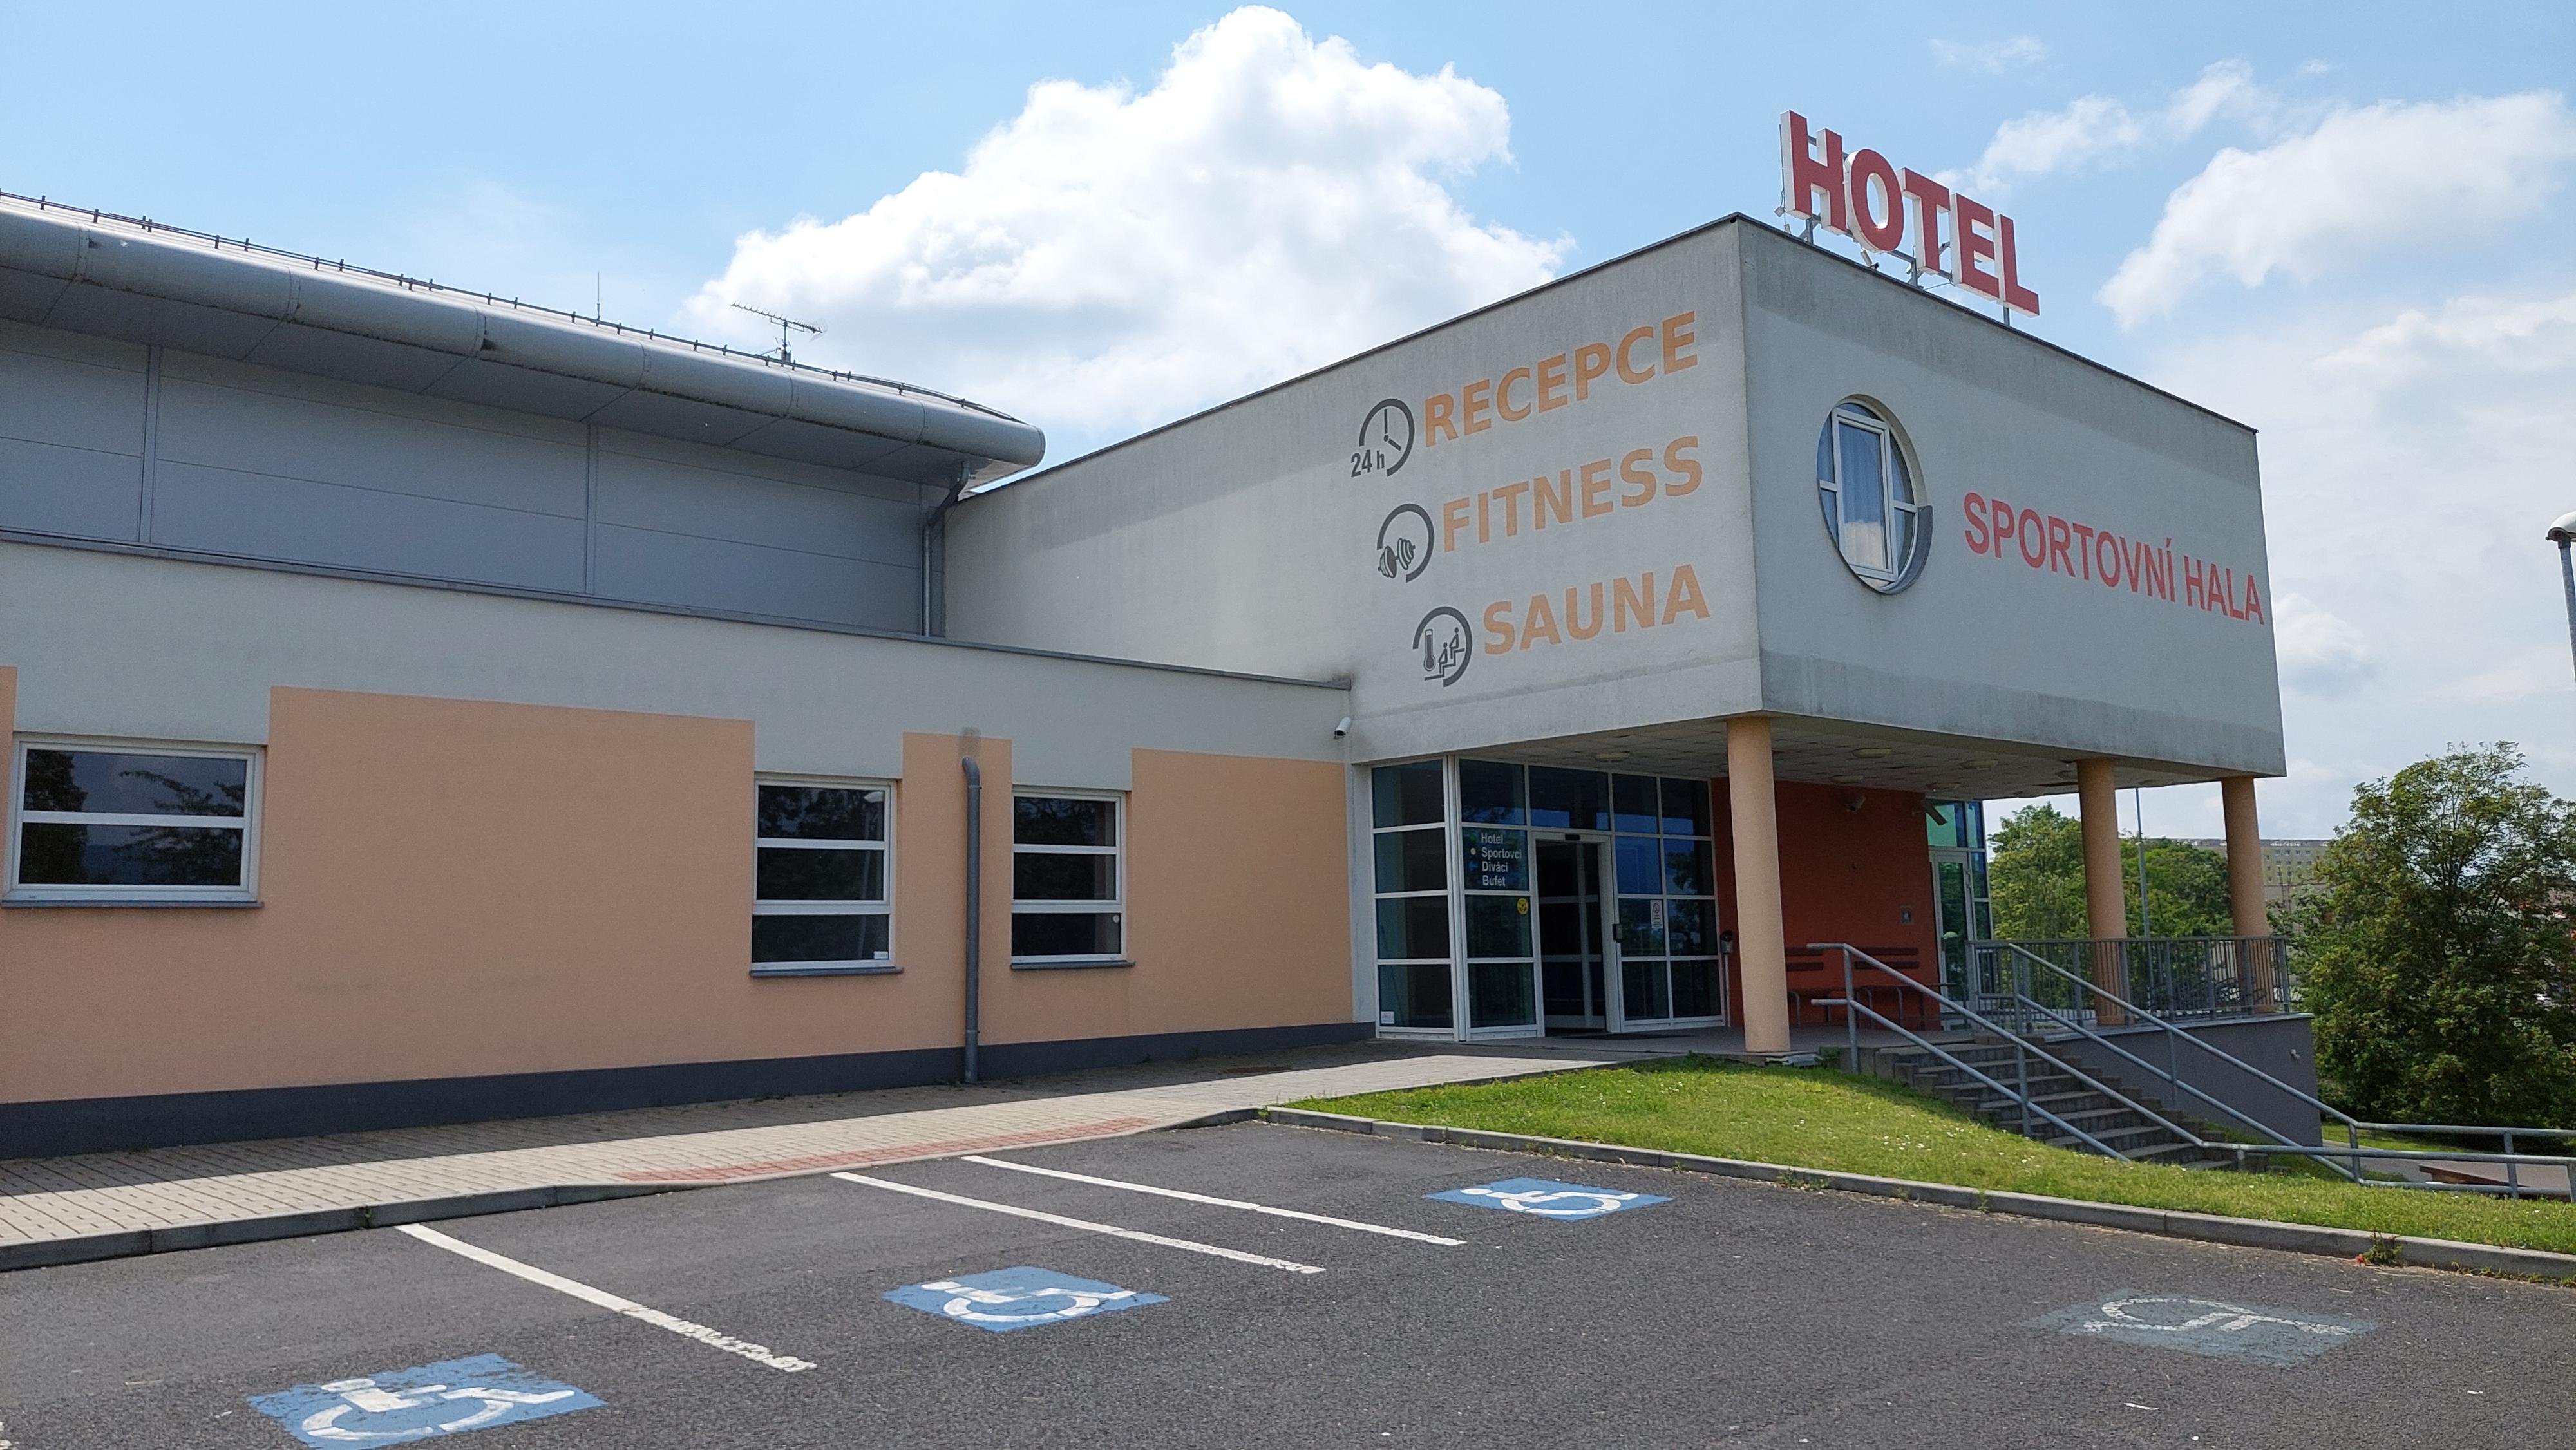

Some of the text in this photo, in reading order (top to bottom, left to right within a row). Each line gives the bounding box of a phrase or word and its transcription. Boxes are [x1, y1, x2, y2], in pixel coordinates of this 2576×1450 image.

[1780, 110, 2040, 317] HOTEL
[1425, 311, 1698, 447] RECEPCE
[1443, 436, 1703, 552] FITNESS
[1964, 492, 2265, 625] SPORTOVNÍ HALA
[1483, 564, 1710, 655] SAUNA
[1481, 832, 1504, 845] Hotel
[1481, 847, 1522, 860] Sportovci
[1482, 861, 1508, 872] Diváci
[1482, 875, 1506, 887] Bufet
